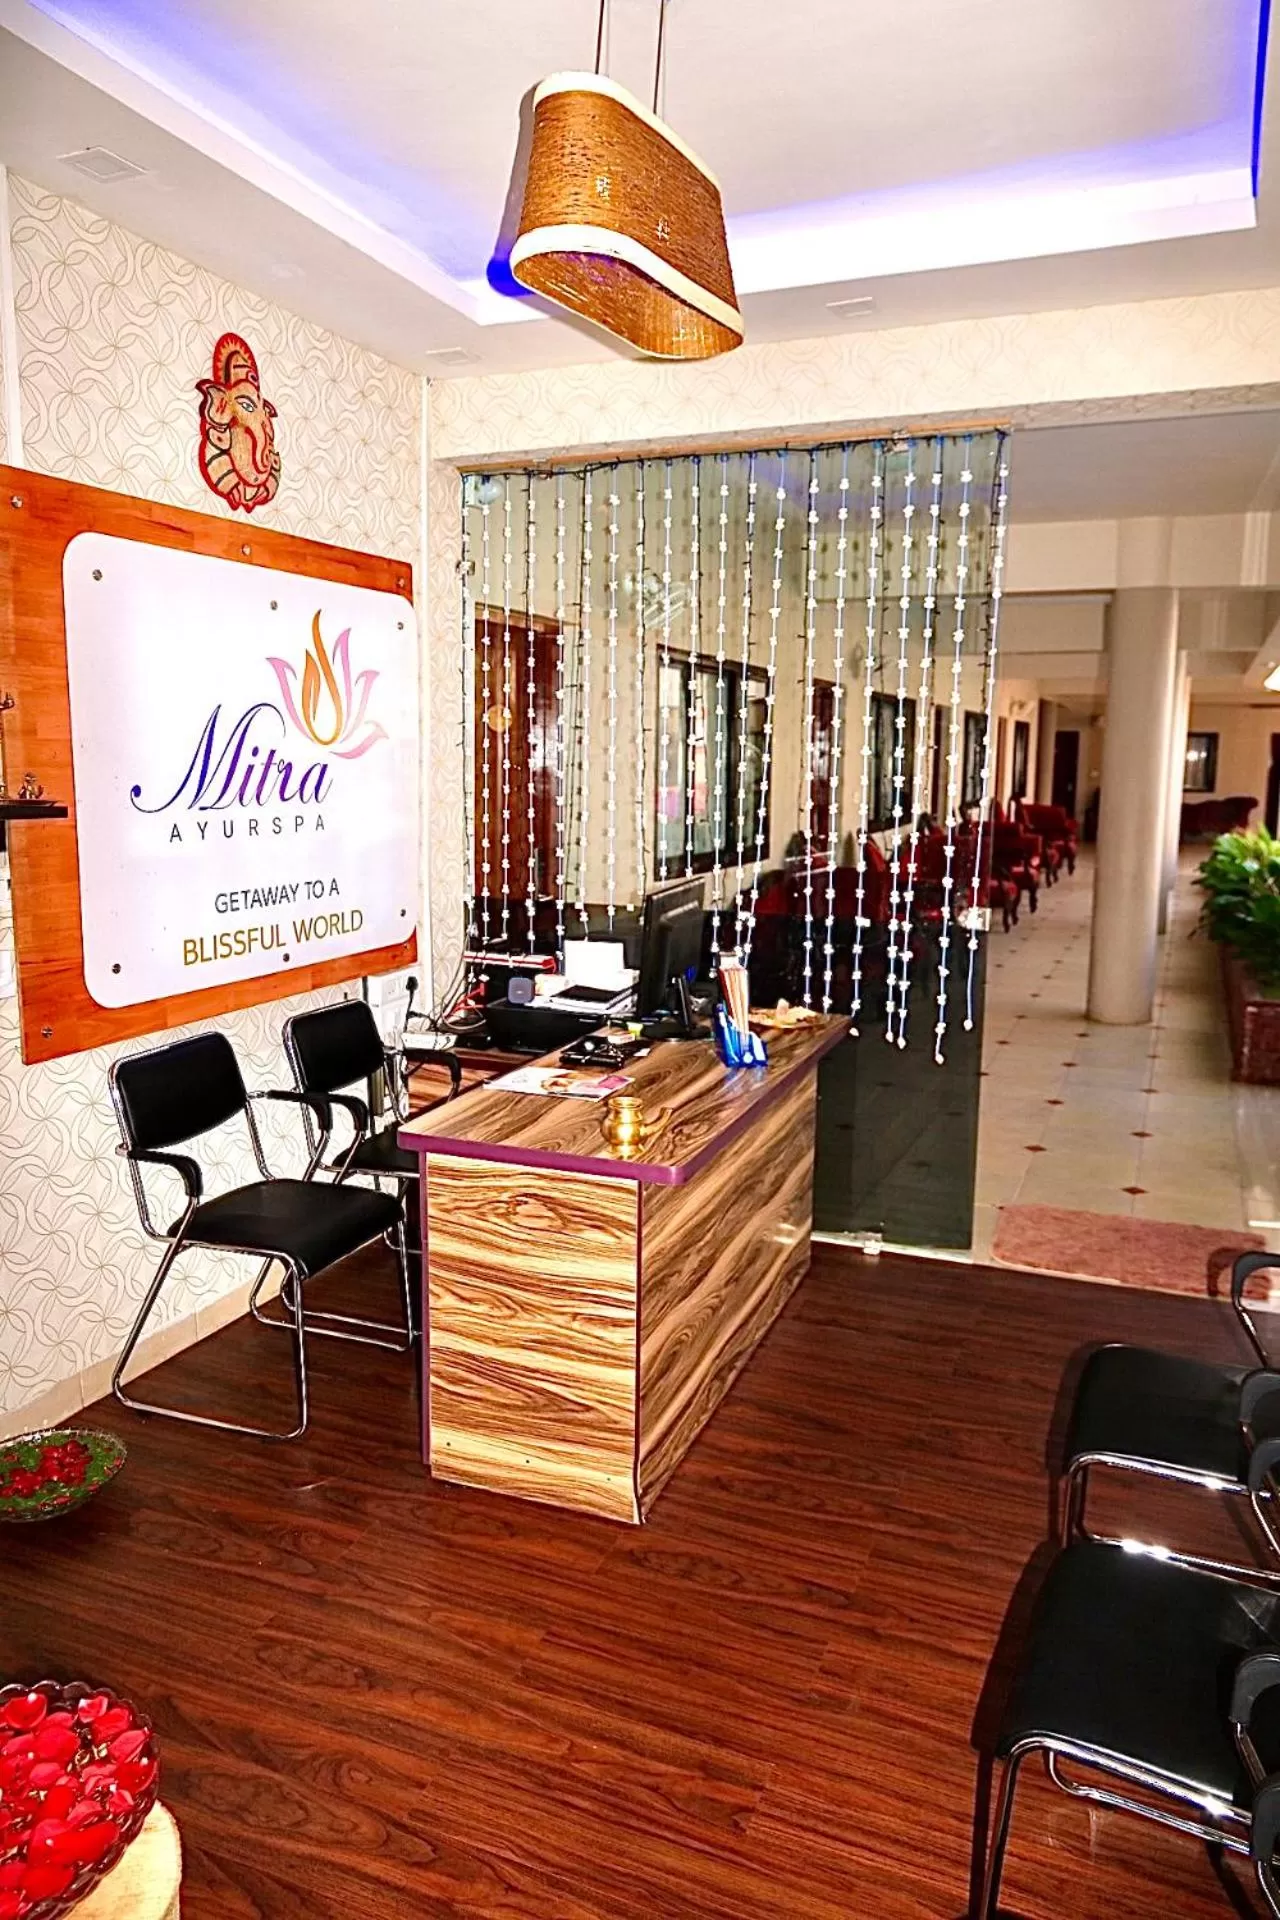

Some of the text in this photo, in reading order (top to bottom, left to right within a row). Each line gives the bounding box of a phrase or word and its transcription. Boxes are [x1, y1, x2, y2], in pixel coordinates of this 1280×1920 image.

[130, 702, 333, 813] Mitra
[169, 814, 325, 843] AYURSPA
[215, 877, 340, 914] GETAWAY TO A
[183, 908, 364, 966] BLISSFUL WORLD
